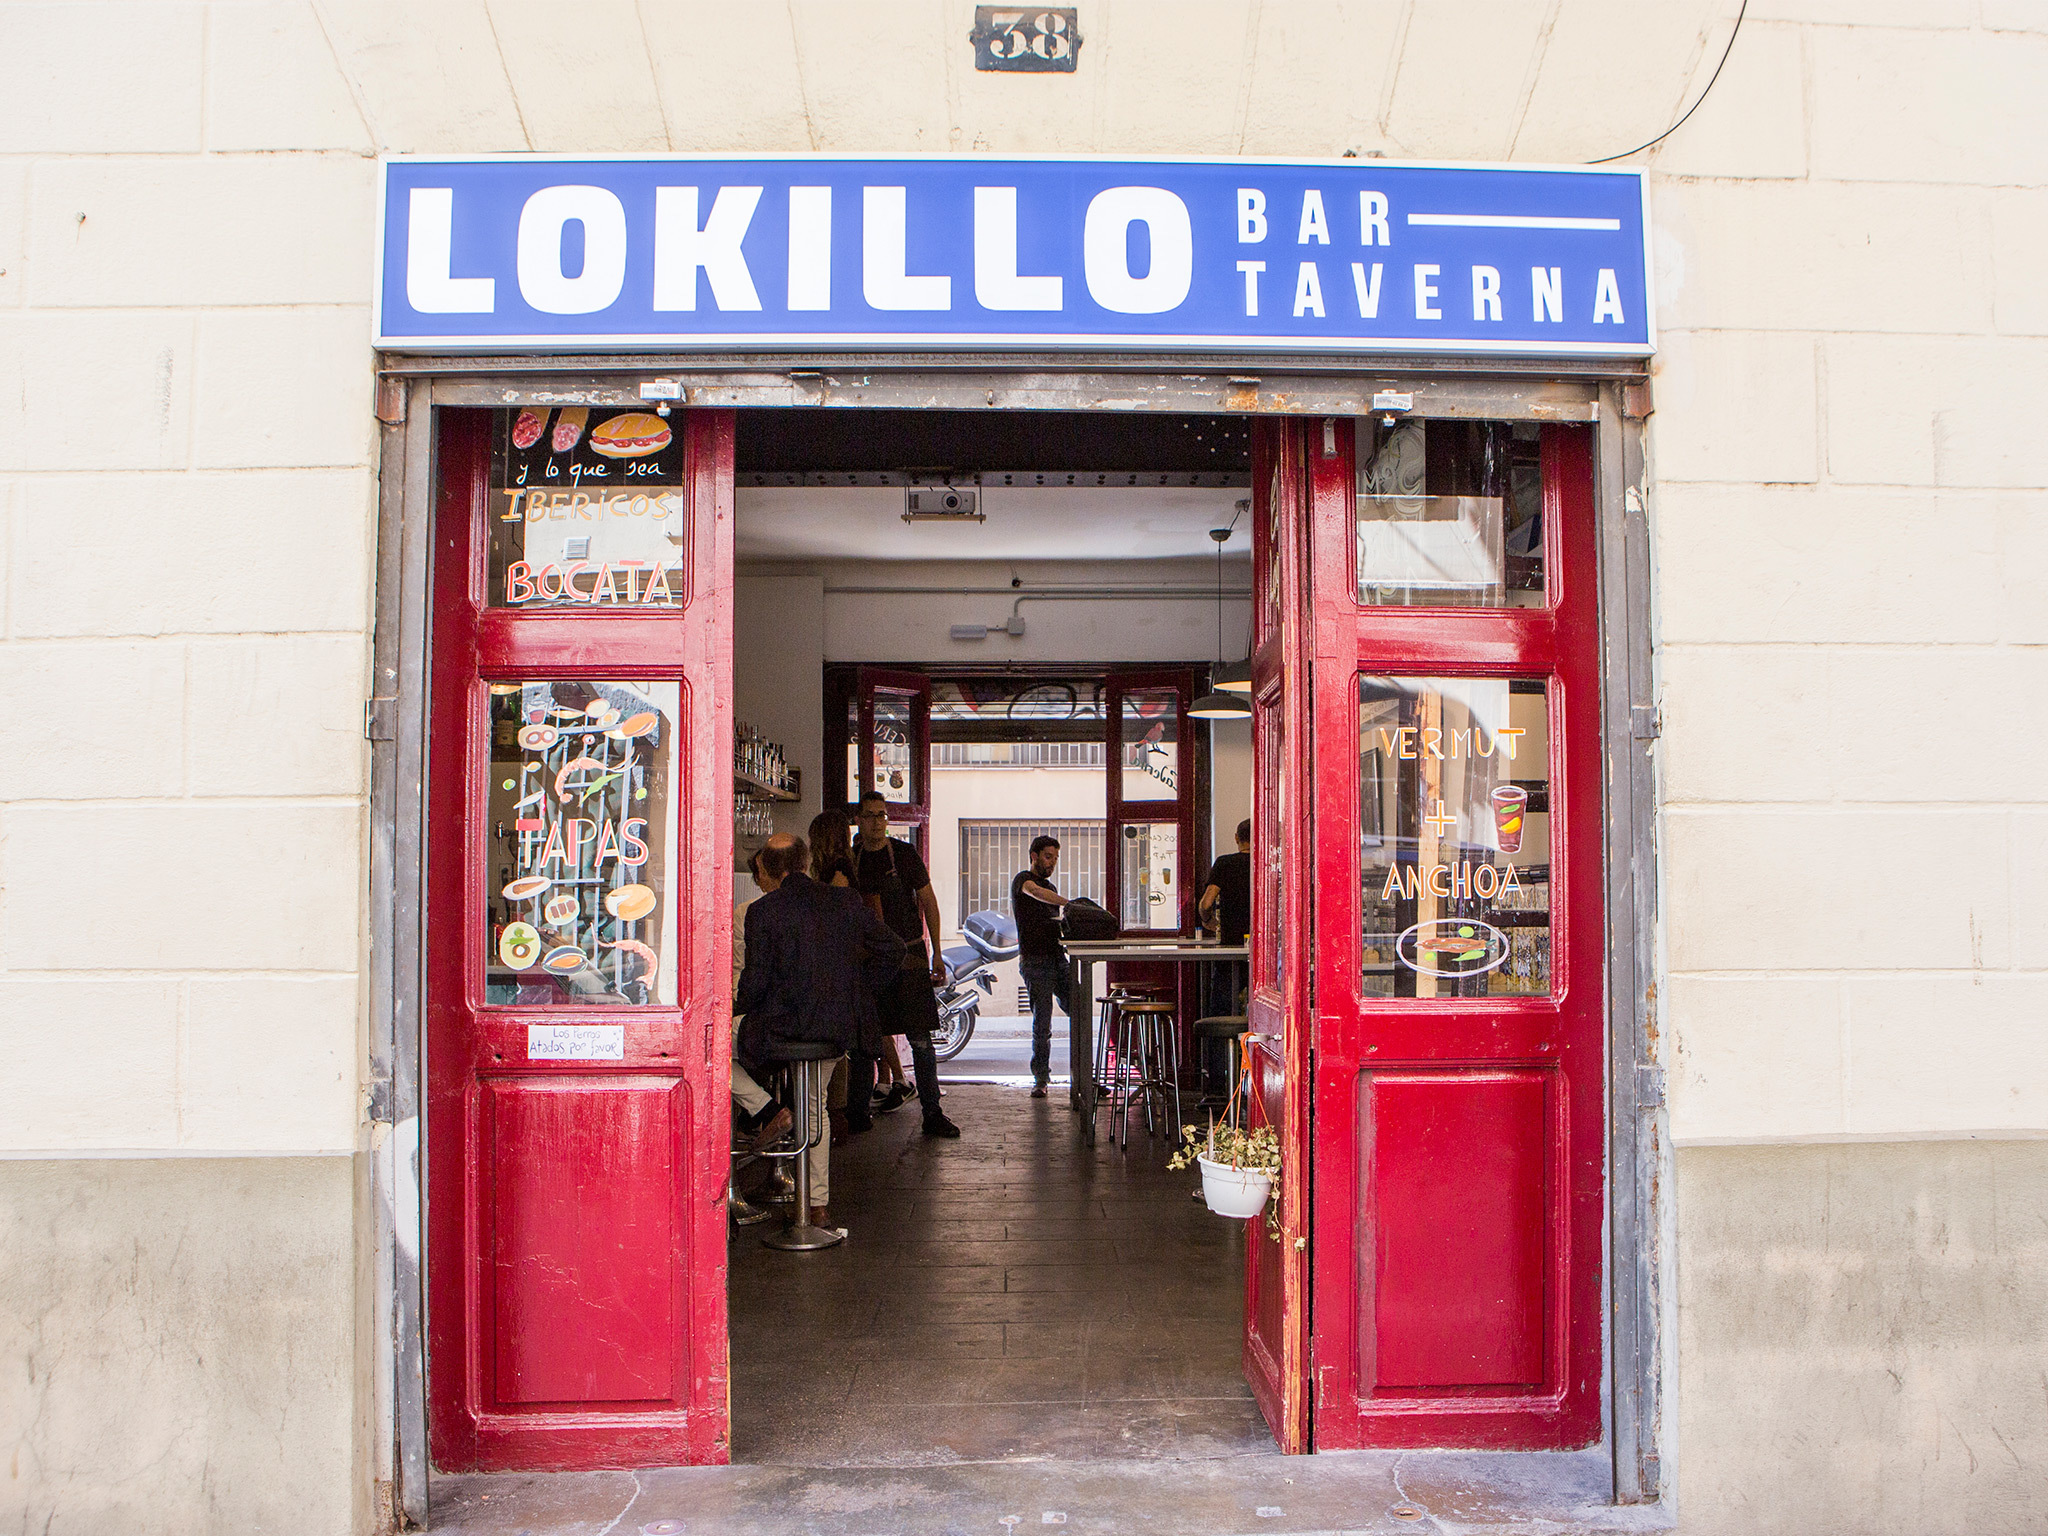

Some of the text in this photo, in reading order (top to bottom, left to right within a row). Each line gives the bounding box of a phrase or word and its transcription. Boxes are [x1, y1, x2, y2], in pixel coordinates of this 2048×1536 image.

[990, 12, 1068, 60] 38
[1236, 188, 1391, 247] BAR
[406, 184, 1193, 315] LOKILLO
[1236, 260, 1625, 325] TAVERNA
[516, 457, 666, 488] y lo que sea
[506, 560, 673, 604] BOCATA
[1380, 727, 1526, 760] VERMUT
[515, 818, 649, 869] TAPAS
[1381, 861, 1526, 900] ANCHOA
[529, 1040, 565, 1055] Atados
[553, 1026, 601, 1039] Los Perros
